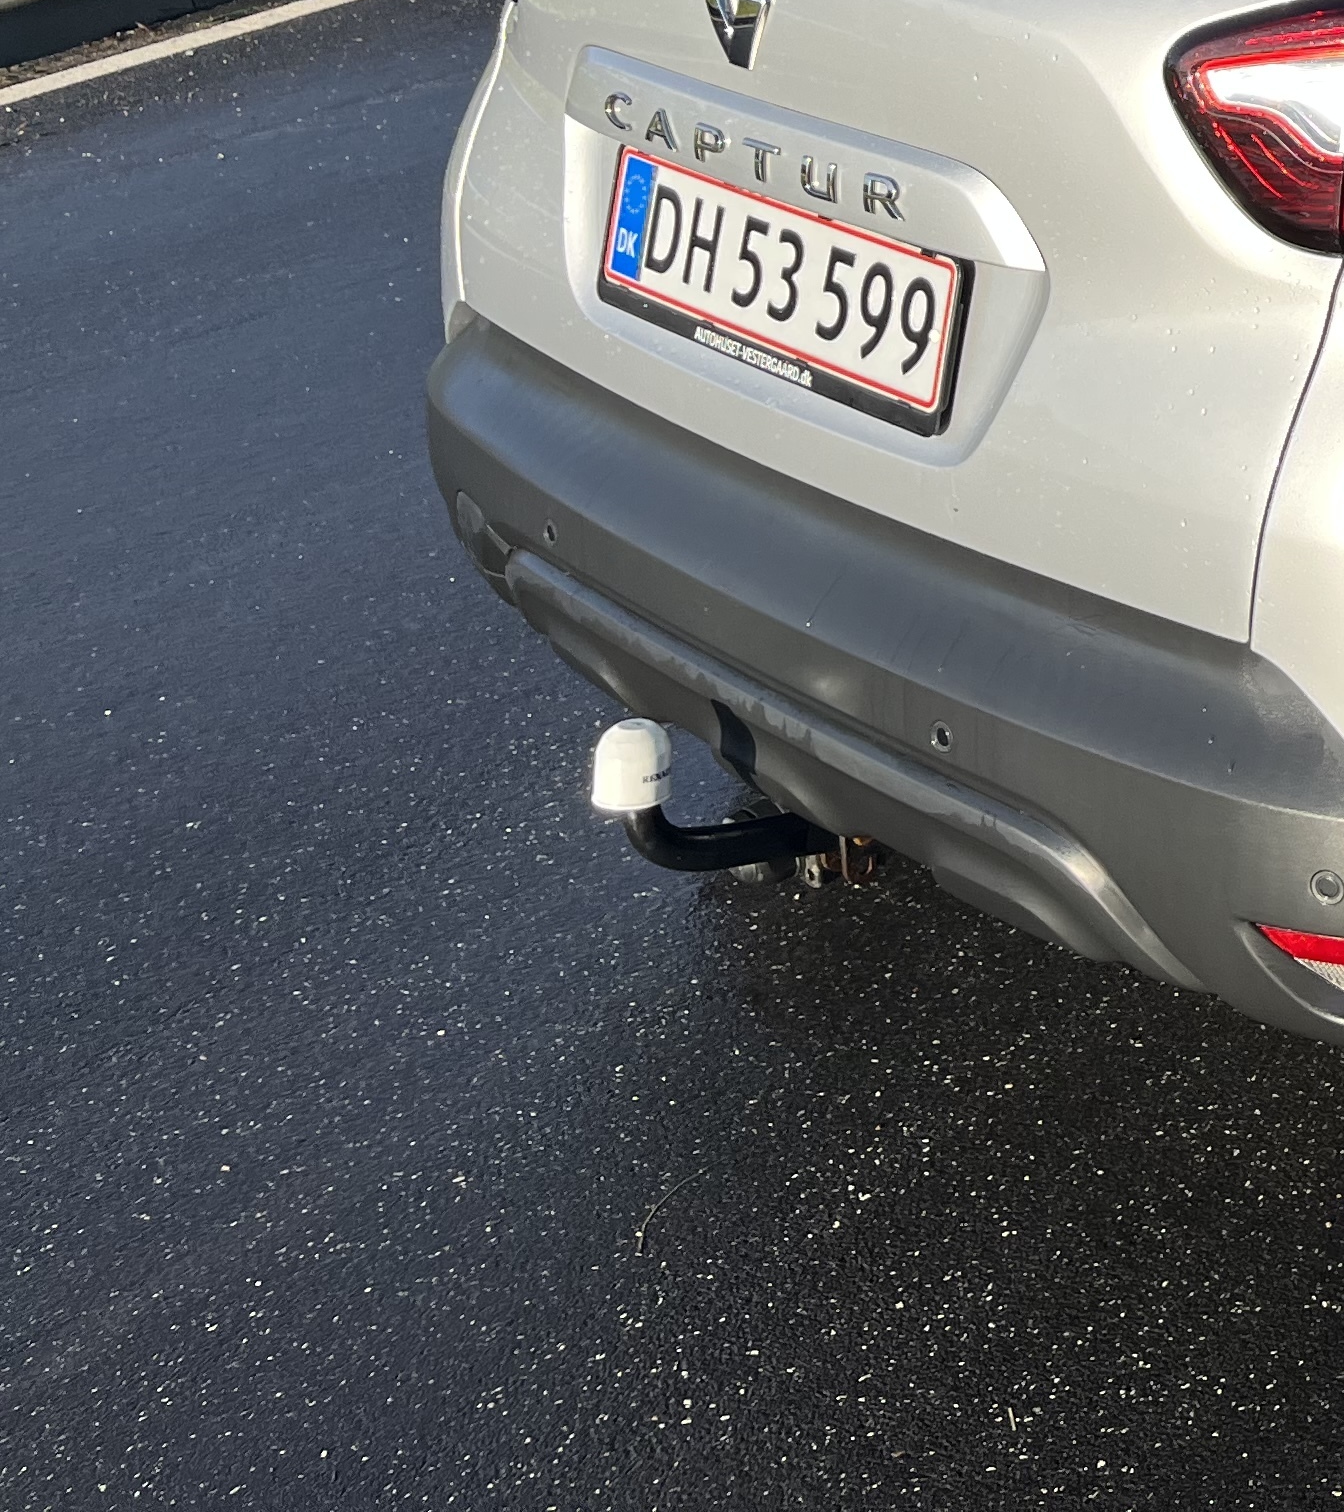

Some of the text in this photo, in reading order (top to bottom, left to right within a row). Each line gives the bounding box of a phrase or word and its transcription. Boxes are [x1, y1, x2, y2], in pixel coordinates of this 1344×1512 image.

[604, 91, 906, 222] CAPTUR
[616, 226, 639, 259] DK
[644, 182, 938, 376] DH 53 599
